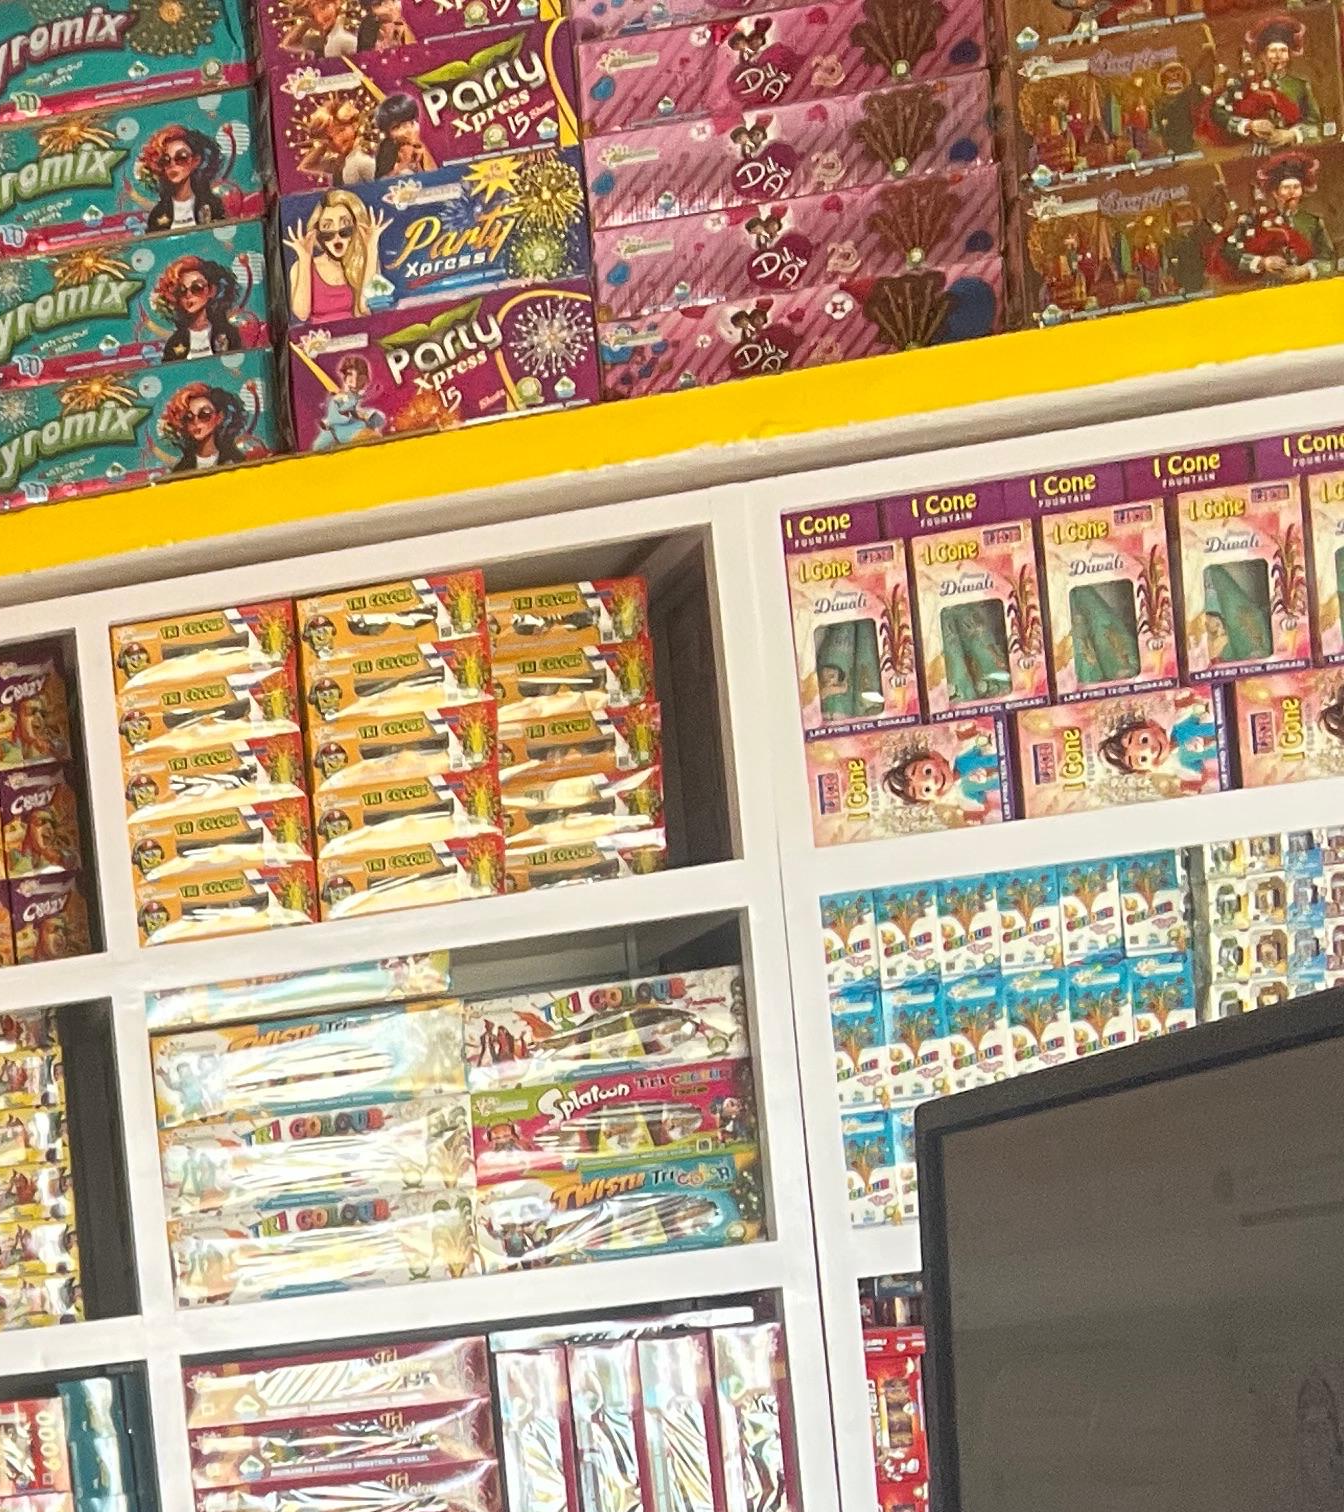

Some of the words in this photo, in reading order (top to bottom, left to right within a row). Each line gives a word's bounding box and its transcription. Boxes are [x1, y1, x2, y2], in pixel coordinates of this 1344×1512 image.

[421, 50, 548, 127] Party
[450, 88, 531, 138] Xpress
[507, 110, 531, 140] 15
[386, 203, 524, 270] Party
[404, 250, 486, 278] Xpress
[385, 314, 503, 385] Party
[413, 349, 488, 391] Xpress
[440, 386, 463, 413] 15
[1154, 458, 1161, 479] I
[1167, 452, 1221, 476] Cone
[1029, 478, 1037, 498] I
[1044, 472, 1096, 497] Cone
[911, 498, 918, 518] I
[925, 491, 978, 515] Cone
[1202, 498, 1246, 519] Cone
[785, 518, 792, 539] I
[799, 512, 852, 537] Cone
[1067, 518, 1109, 542] Cone
[936, 539, 979, 562] Cone
[1205, 533, 1260, 554] Diwali
[811, 558, 853, 581] Cone
[1068, 555, 1126, 577] Diwali
[939, 574, 994, 598] Diwali
[813, 592, 867, 615] Diwali
[1278, 696, 1305, 748] Cone
[1060, 726, 1085, 778] Cone
[846, 758, 870, 809] Cone
[588, 976, 687, 1012] COLOUR
[537, 1082, 631, 1123] Splatoon
[289, 1107, 385, 1139] COLOUR
[295, 1199, 390, 1231] COLOUR
